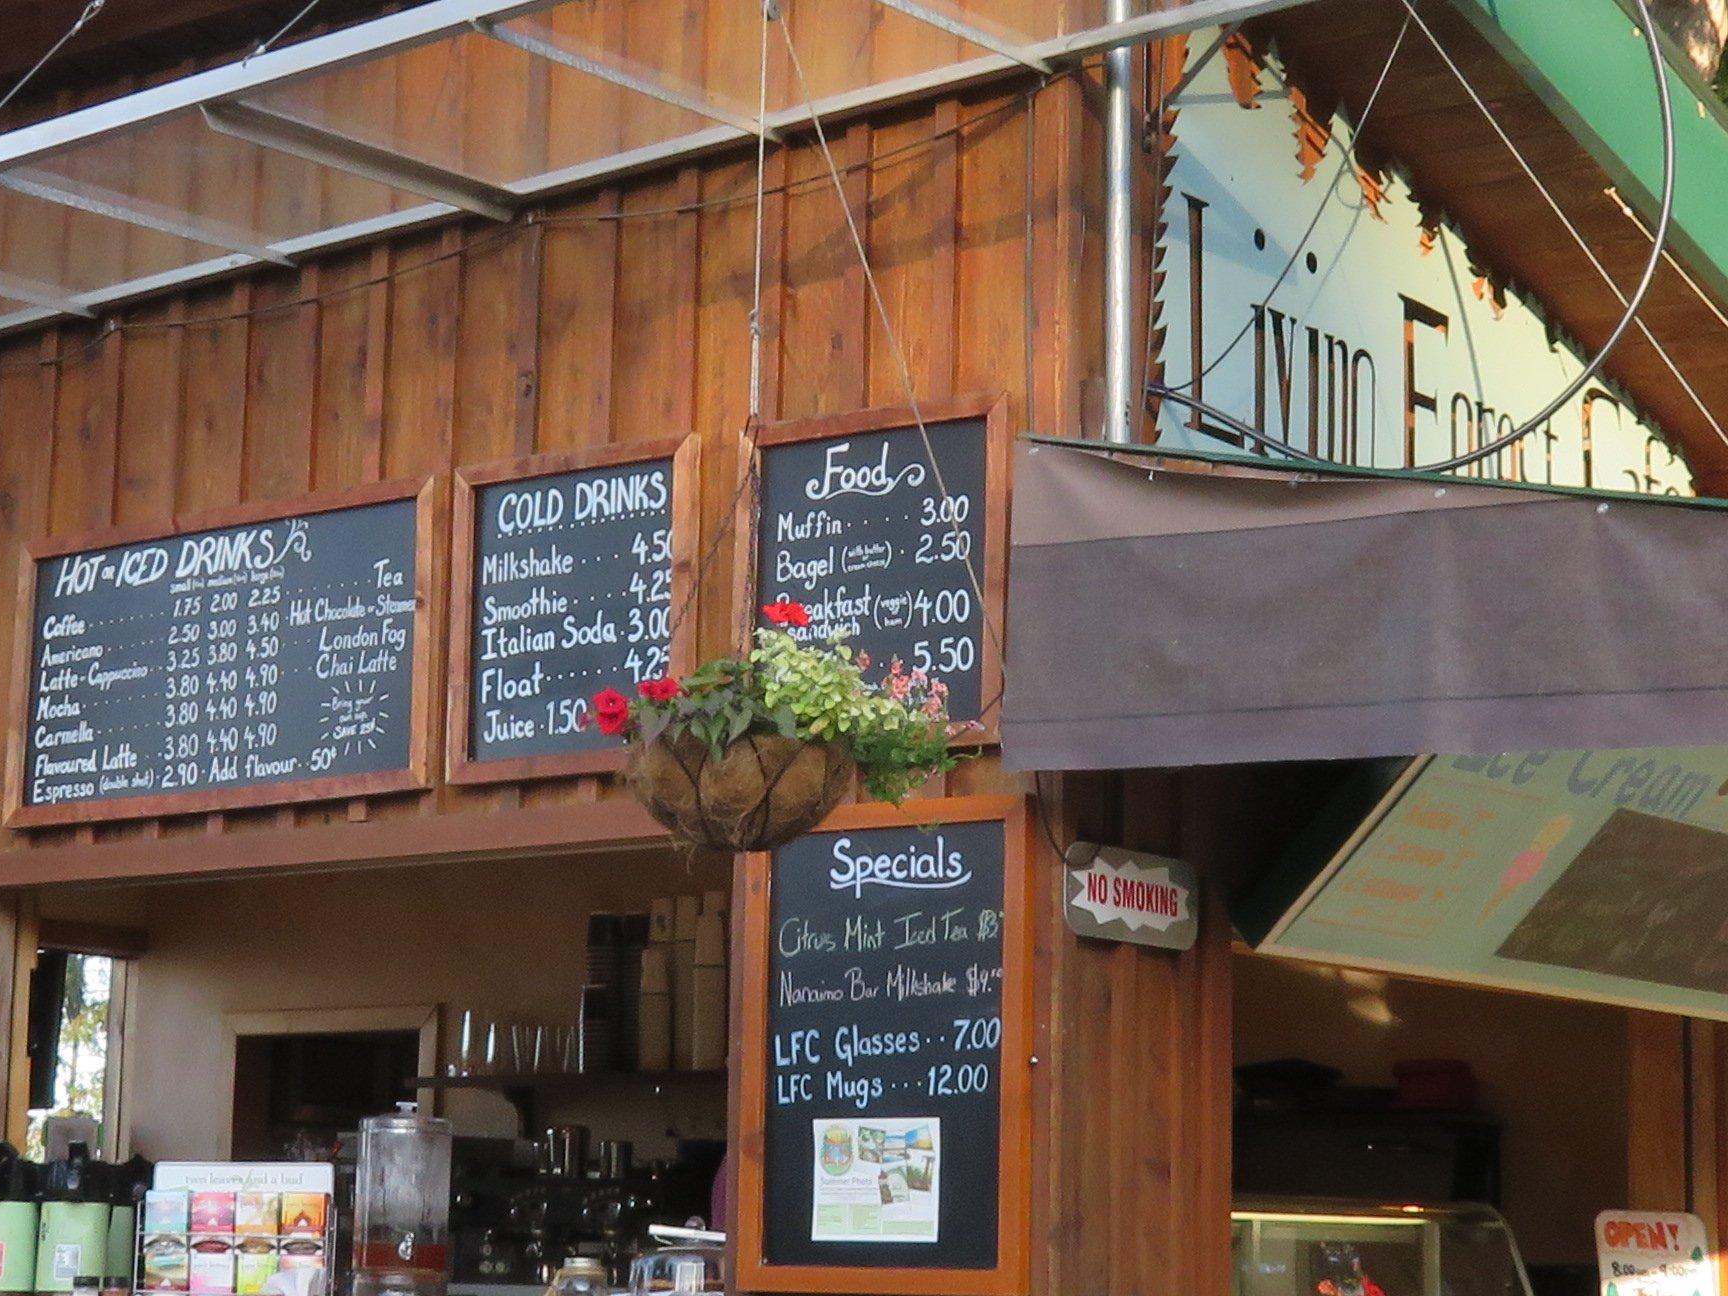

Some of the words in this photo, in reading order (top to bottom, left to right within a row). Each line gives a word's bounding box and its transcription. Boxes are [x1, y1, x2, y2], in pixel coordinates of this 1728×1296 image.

[805, 441, 898, 500] Food
[498, 488, 564, 533] COLD
[575, 471, 667, 520] DRINKS
[777, 510, 843, 542] Muffin
[920, 495, 970, 526] 3.00
[54, 554, 106, 597] HOT
[115, 548, 168, 587] ICED
[175, 529, 275, 578] DRINKS
[482, 544, 573, 585] Milkshake
[776, 546, 834, 590] Bagel
[915, 531, 971, 564] 2.50
[43, 614, 86, 640] Coffee
[173, 596, 202, 618] 1.75
[210, 592, 238, 612] 2.00
[248, 585, 281, 607] 2.25
[373, 558, 404, 589] Tea
[483, 586, 568, 625] Smoothie
[913, 588, 970, 628] 4.00
[41, 643, 103, 668] Americano
[168, 623, 201, 645] 2.50
[207, 619, 237, 641] 3.00
[246, 611, 280, 635] 3.40
[290, 598, 312, 626] Hot
[314, 595, 366, 622] Chocolate
[167, 647, 200, 672] 3.25
[207, 642, 238, 666] 3.80
[245, 636, 279, 661] 4.50
[319, 625, 378, 652] London
[382, 618, 407, 652] Fog
[480, 624, 555, 661] Italian
[561, 609, 618, 649] Soda
[627, 607, 670, 644] 3.00
[913, 637, 974, 673] 5.50
[36, 694, 80, 721] Mocha
[165, 674, 200, 700] 3.80
[206, 670, 238, 694] 4.40
[245, 663, 278, 689] 4.90
[316, 653, 353, 679] Chai
[357, 649, 398, 674] Latte
[481, 660, 544, 704] Float
[35, 720, 94, 749] Carmella
[164, 701, 199, 728] 3.80
[205, 696, 238, 721] 4.40
[244, 690, 277, 718] 4.90
[483, 709, 535, 744] Juice
[546, 697, 588, 735] 1.50
[35, 749, 97, 778] Flavoured
[102, 743, 138, 771] Latte
[163, 733, 200, 761] 3.80
[206, 726, 239, 754] 4.40
[243, 722, 277, 750] 4.90
[33, 778, 95, 804] Espresso
[161, 762, 198, 789] 2.90
[208, 755, 238, 783] Add
[245, 754, 297, 778] flavour
[830, 835, 965, 899] Specials
[1088, 872, 1107, 905] NO
[1113, 877, 1178, 917] SMOKING
[779, 917, 836, 958] Citrus
[844, 915, 885, 952] Mint
[894, 912, 936, 950] Iced
[941, 907, 969, 941] Tea
[780, 970, 844, 1007] Nanaimo
[845, 967, 879, 1001] Bar
[887, 964, 957, 1002] Milkshake
[775, 1029, 821, 1067] LFC
[835, 1024, 920, 1067] Glasses
[954, 1017, 1001, 1051] 7.00
[777, 1074, 813, 1104] LFC
[826, 1071, 883, 1109] Mugs
[927, 1063, 989, 1096] 12.00
[1604, 1220, 1679, 1251] OPEN!
